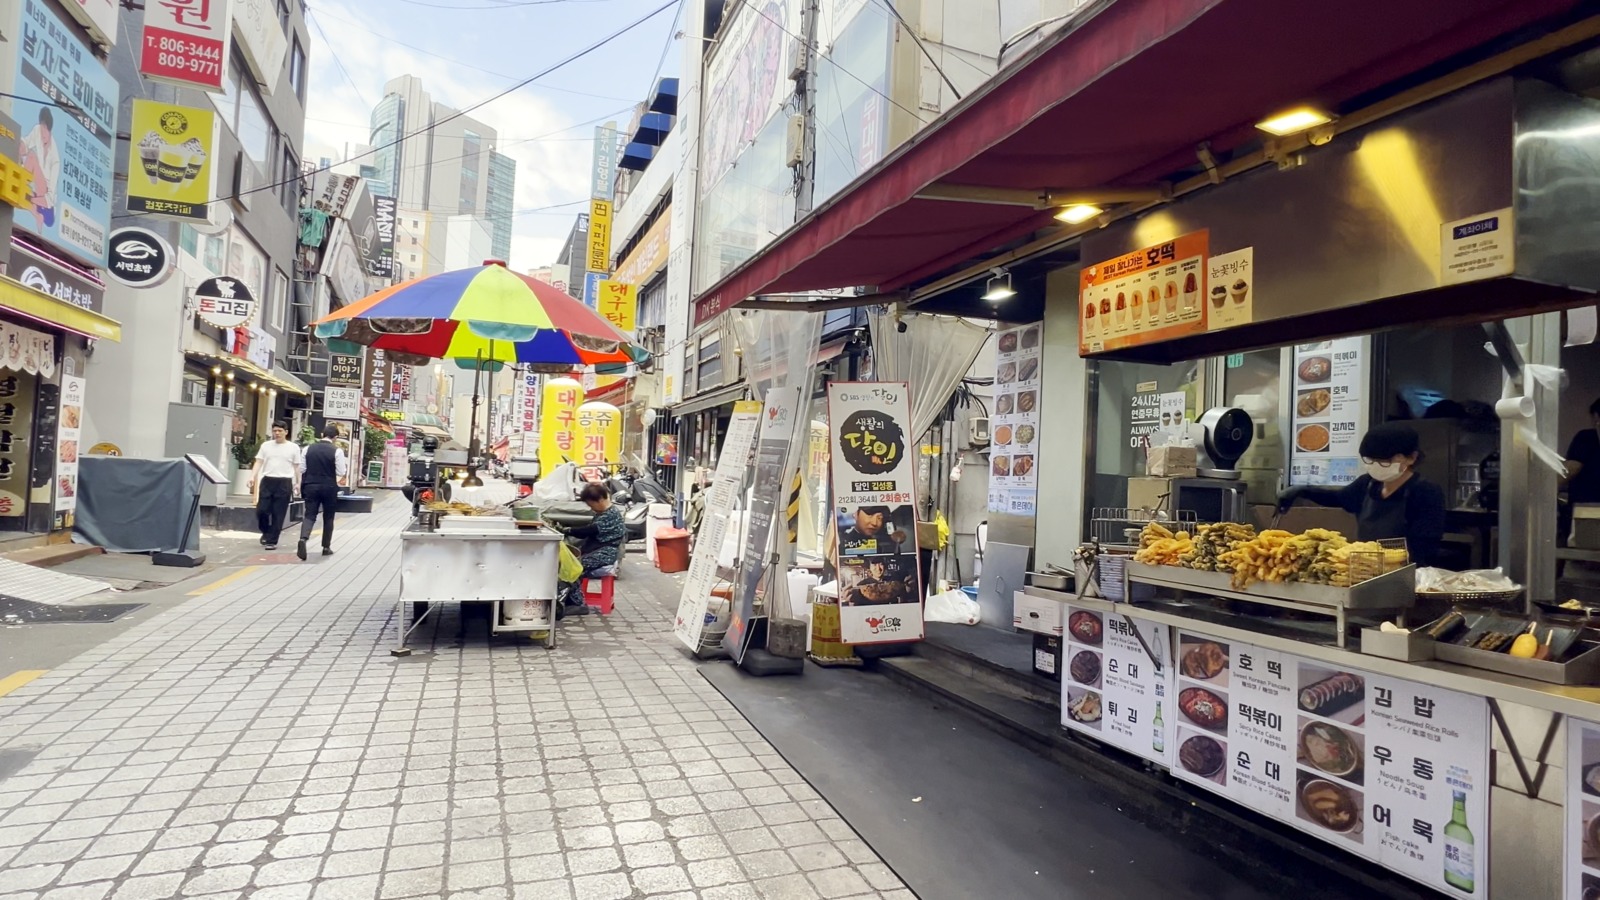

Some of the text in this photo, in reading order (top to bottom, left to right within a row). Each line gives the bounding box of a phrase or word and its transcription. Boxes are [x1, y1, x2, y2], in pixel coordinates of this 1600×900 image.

[160, 36, 220, 61] 806-3444
[158, 52, 219, 76] 809-9771
[115, 260, 153, 274] 서면초밥
[1103, 242, 1176, 275] 제일 잘나가는 호떡
[1211, 259, 1249, 279] 눈꽃빙수
[200, 297, 249, 317] 돈고집
[1131, 394, 1161, 407] 24시간
[1333, 386, 1349, 395] 호떡
[855, 417, 885, 431] 생활의
[1130, 425, 1160, 435] ALWAYS
[1332, 422, 1356, 432] 김치전
[844, 430, 897, 465] 달인
[854, 482, 870, 491] 달인
[879, 492, 911, 503] 2회출연
[1239, 653, 1282, 680] 호떡
[1248, 676, 1267, 686] Korean
[1267, 680, 1291, 692] Pancake
[1373, 686, 1436, 719] 김밥
[1239, 703, 1282, 732] 떡볶이
[1371, 709, 1459, 738] Korean Seaweed Rice Rolls
[1252, 727, 1265, 736] Rice
[1236, 750, 1280, 782] 순대
[1373, 745, 1434, 781] 우동
[1233, 769, 1291, 795] Korean Blood Sausage
[1379, 770, 1425, 791] Noodle Soup
[1372, 804, 1434, 844] 어묵
[1385, 831, 1420, 850] Fish cake
